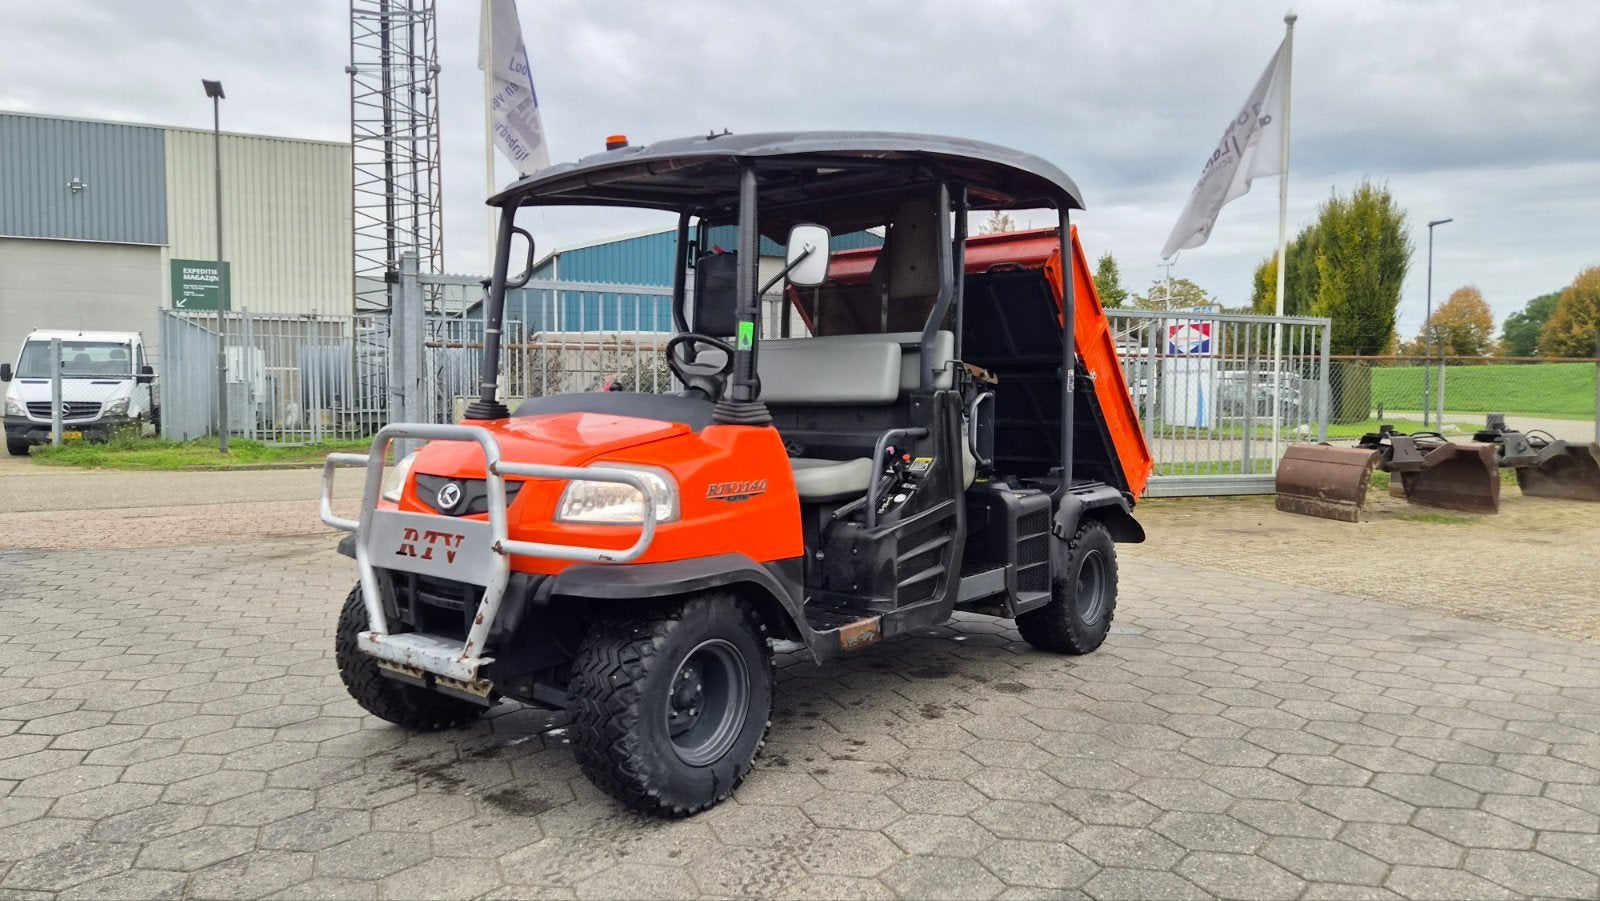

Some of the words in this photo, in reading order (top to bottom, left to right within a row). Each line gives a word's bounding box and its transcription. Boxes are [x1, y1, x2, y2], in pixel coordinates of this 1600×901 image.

[183, 274, 220, 282] MAGAZIJN
[706, 479, 768, 496] RTV1140
[396, 527, 466, 564] RTV
